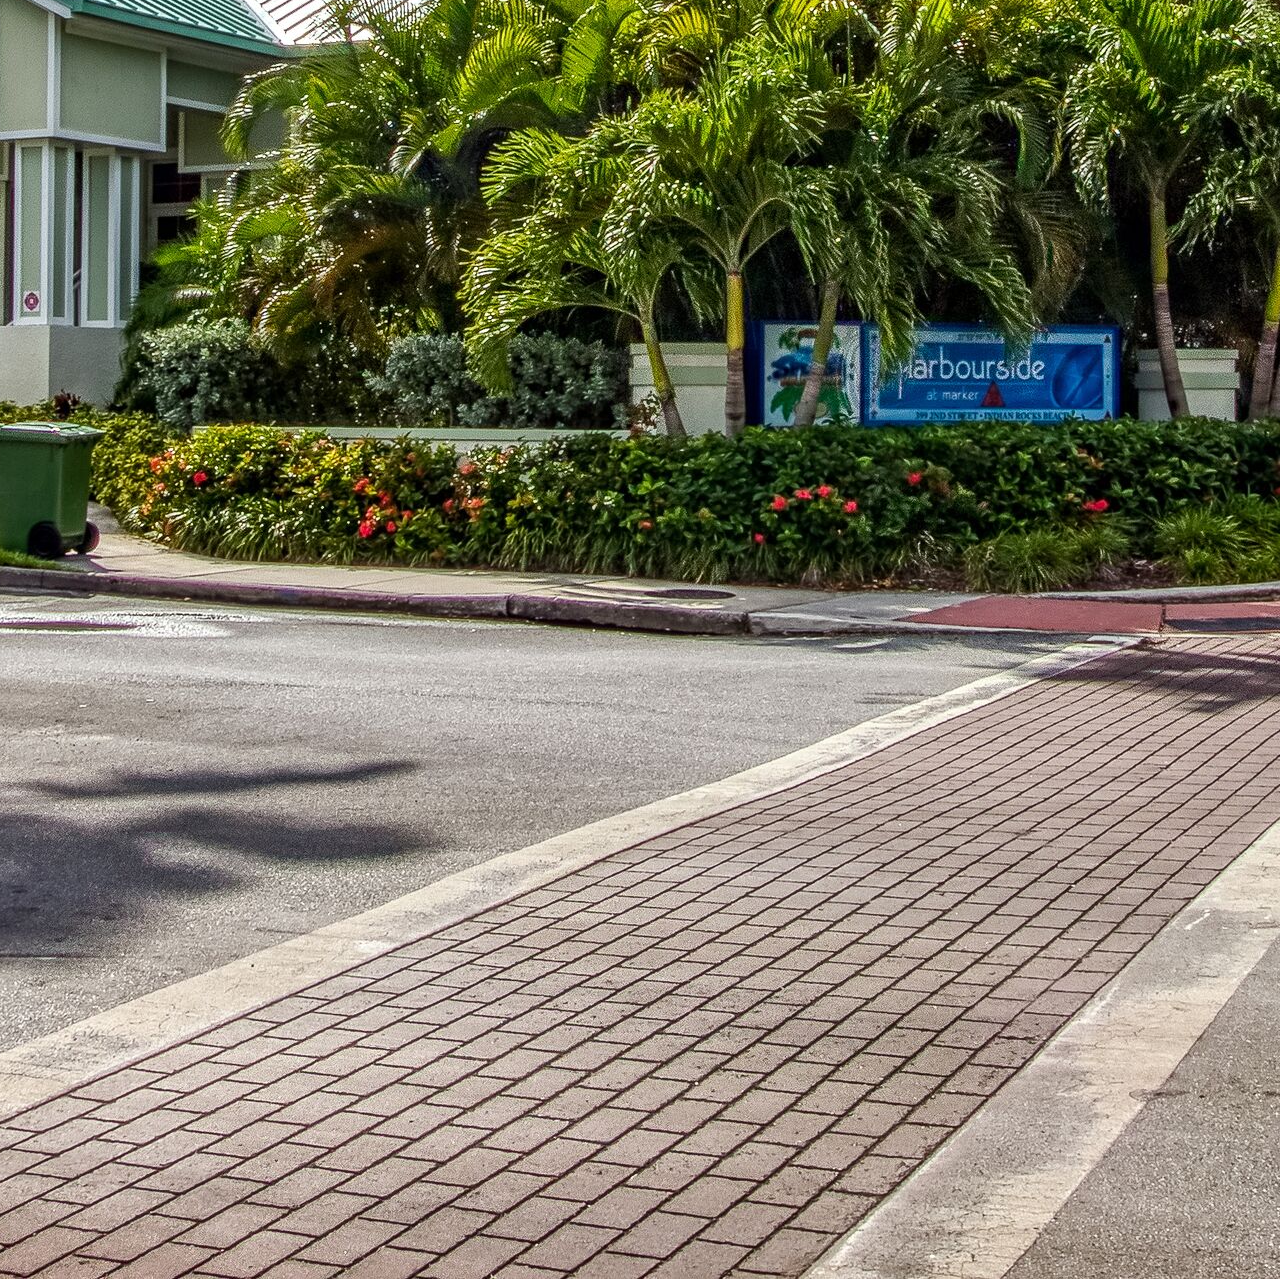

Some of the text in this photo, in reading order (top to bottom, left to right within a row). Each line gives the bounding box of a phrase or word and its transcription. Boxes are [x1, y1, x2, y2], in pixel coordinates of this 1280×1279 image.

[927, 387, 979, 401] at marker
[984, 411, 1014, 420] INDIAN
[1015, 411, 1042, 420] ROCKS
